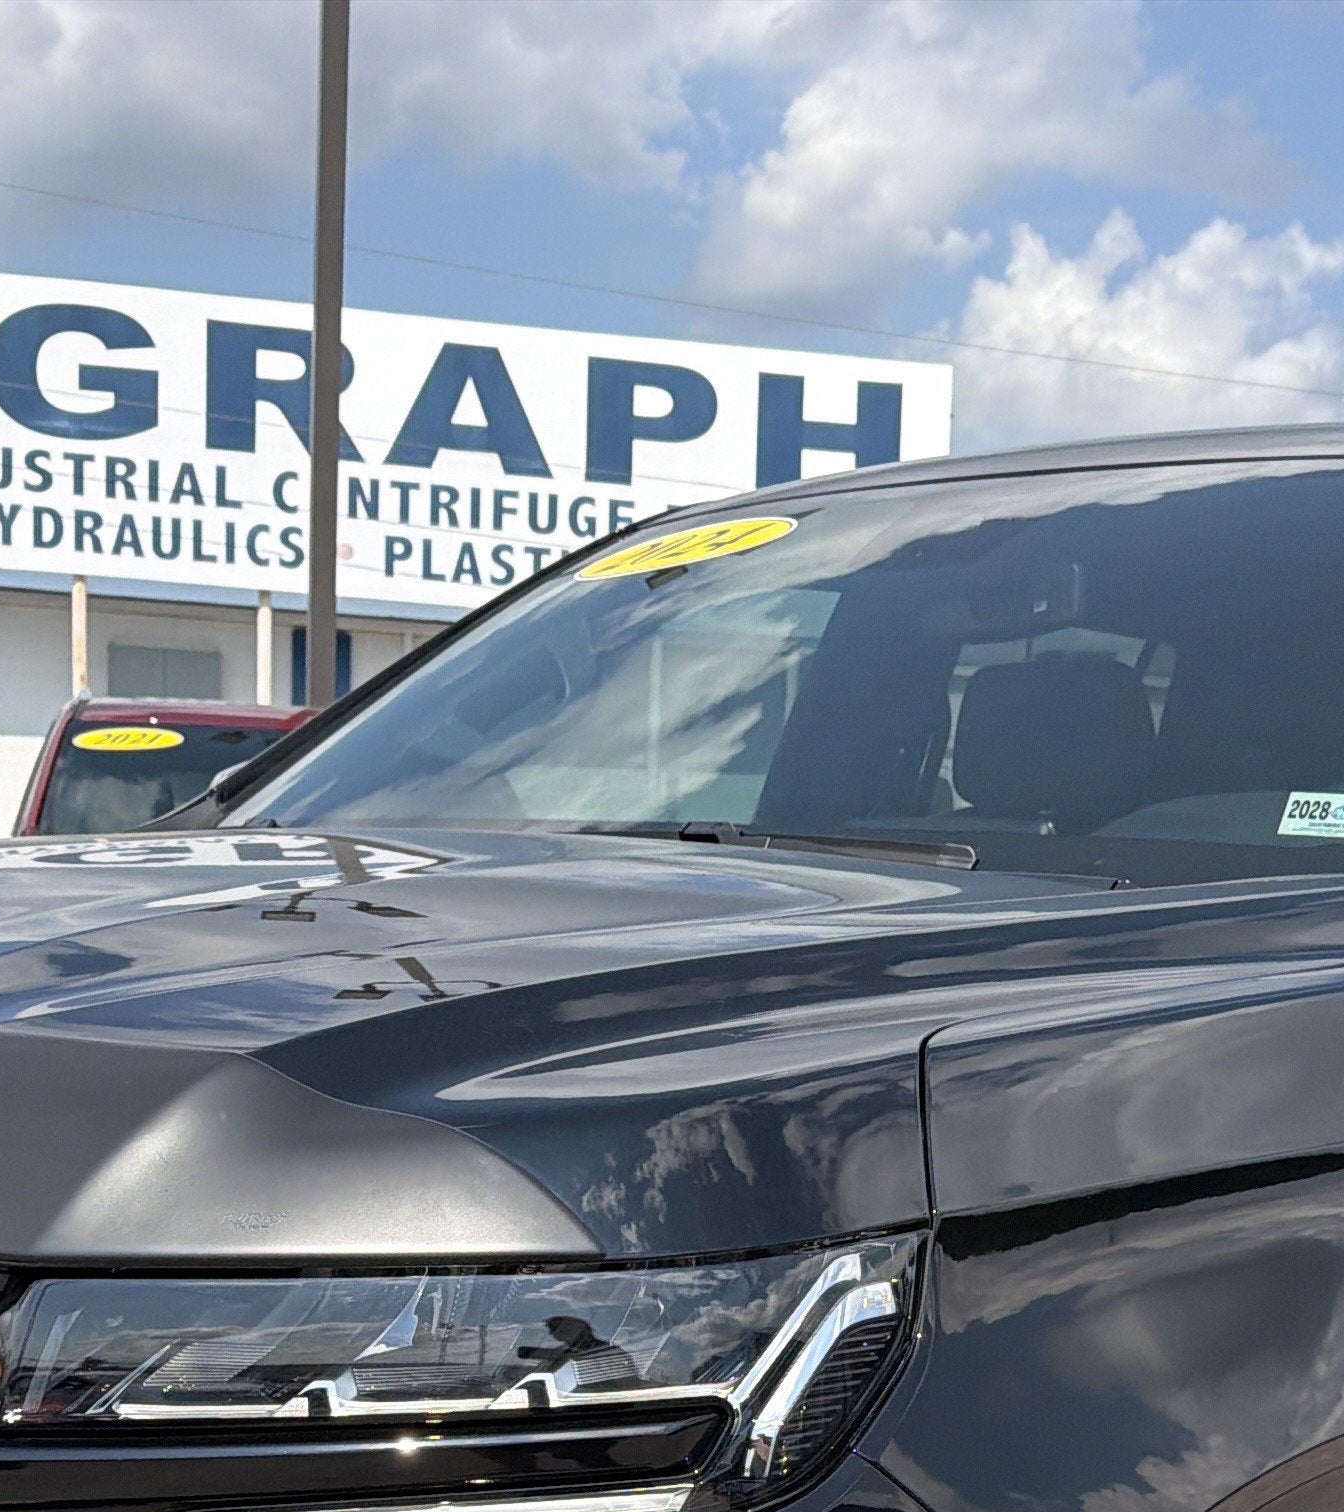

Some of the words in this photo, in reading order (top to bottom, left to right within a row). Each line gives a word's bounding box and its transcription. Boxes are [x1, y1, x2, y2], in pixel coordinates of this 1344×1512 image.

[272, 470, 635, 538] CNTRIFUGE
[384, 534, 573, 586] PLAST
[93, 732, 162, 745] 2021
[1287, 799, 1332, 821] 2028
